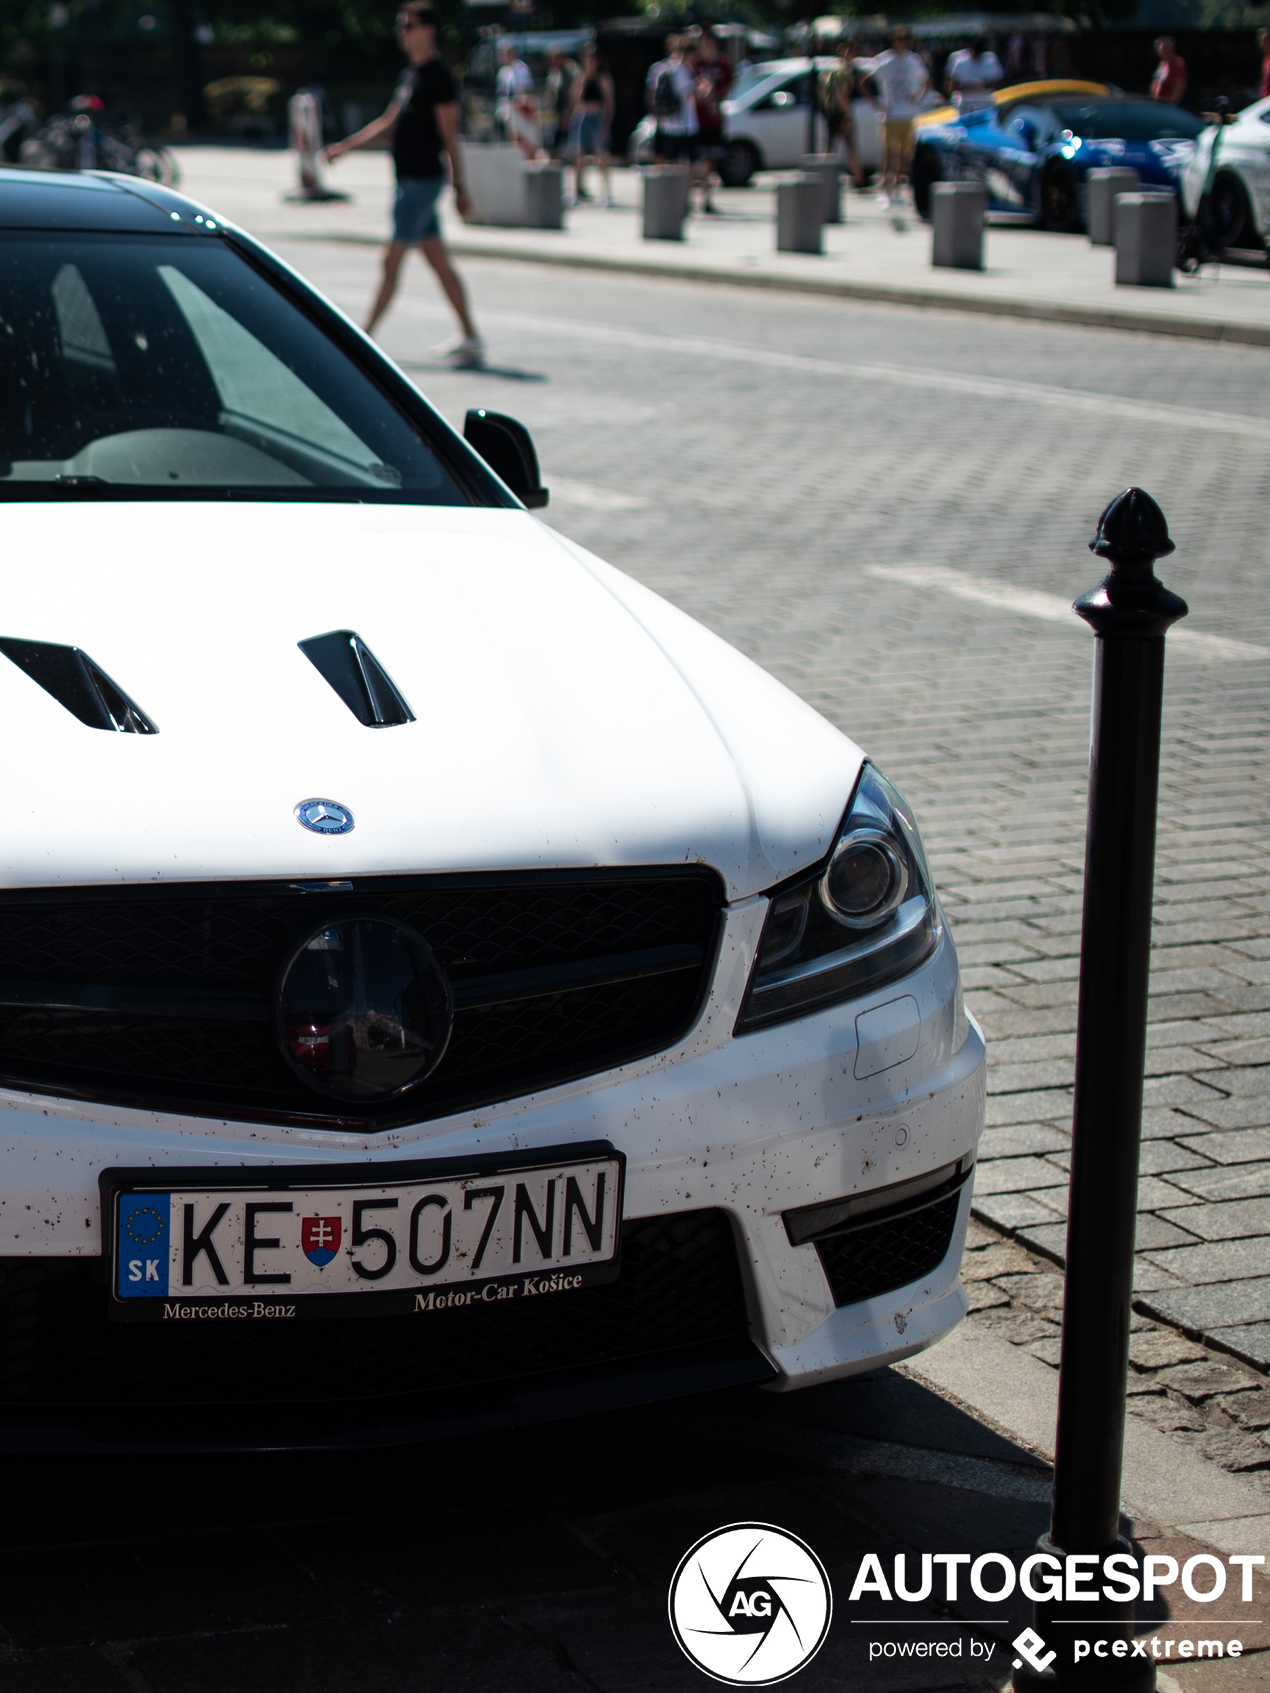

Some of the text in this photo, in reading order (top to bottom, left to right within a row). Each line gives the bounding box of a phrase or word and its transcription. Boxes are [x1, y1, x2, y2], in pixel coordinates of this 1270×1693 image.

[182, 1172, 607, 1285] KE 507NN
[128, 1259, 160, 1282] SK
[414, 1272, 582, 1312] Motor-Car Košice
[164, 1303, 296, 1319] Mercedes-Benz
